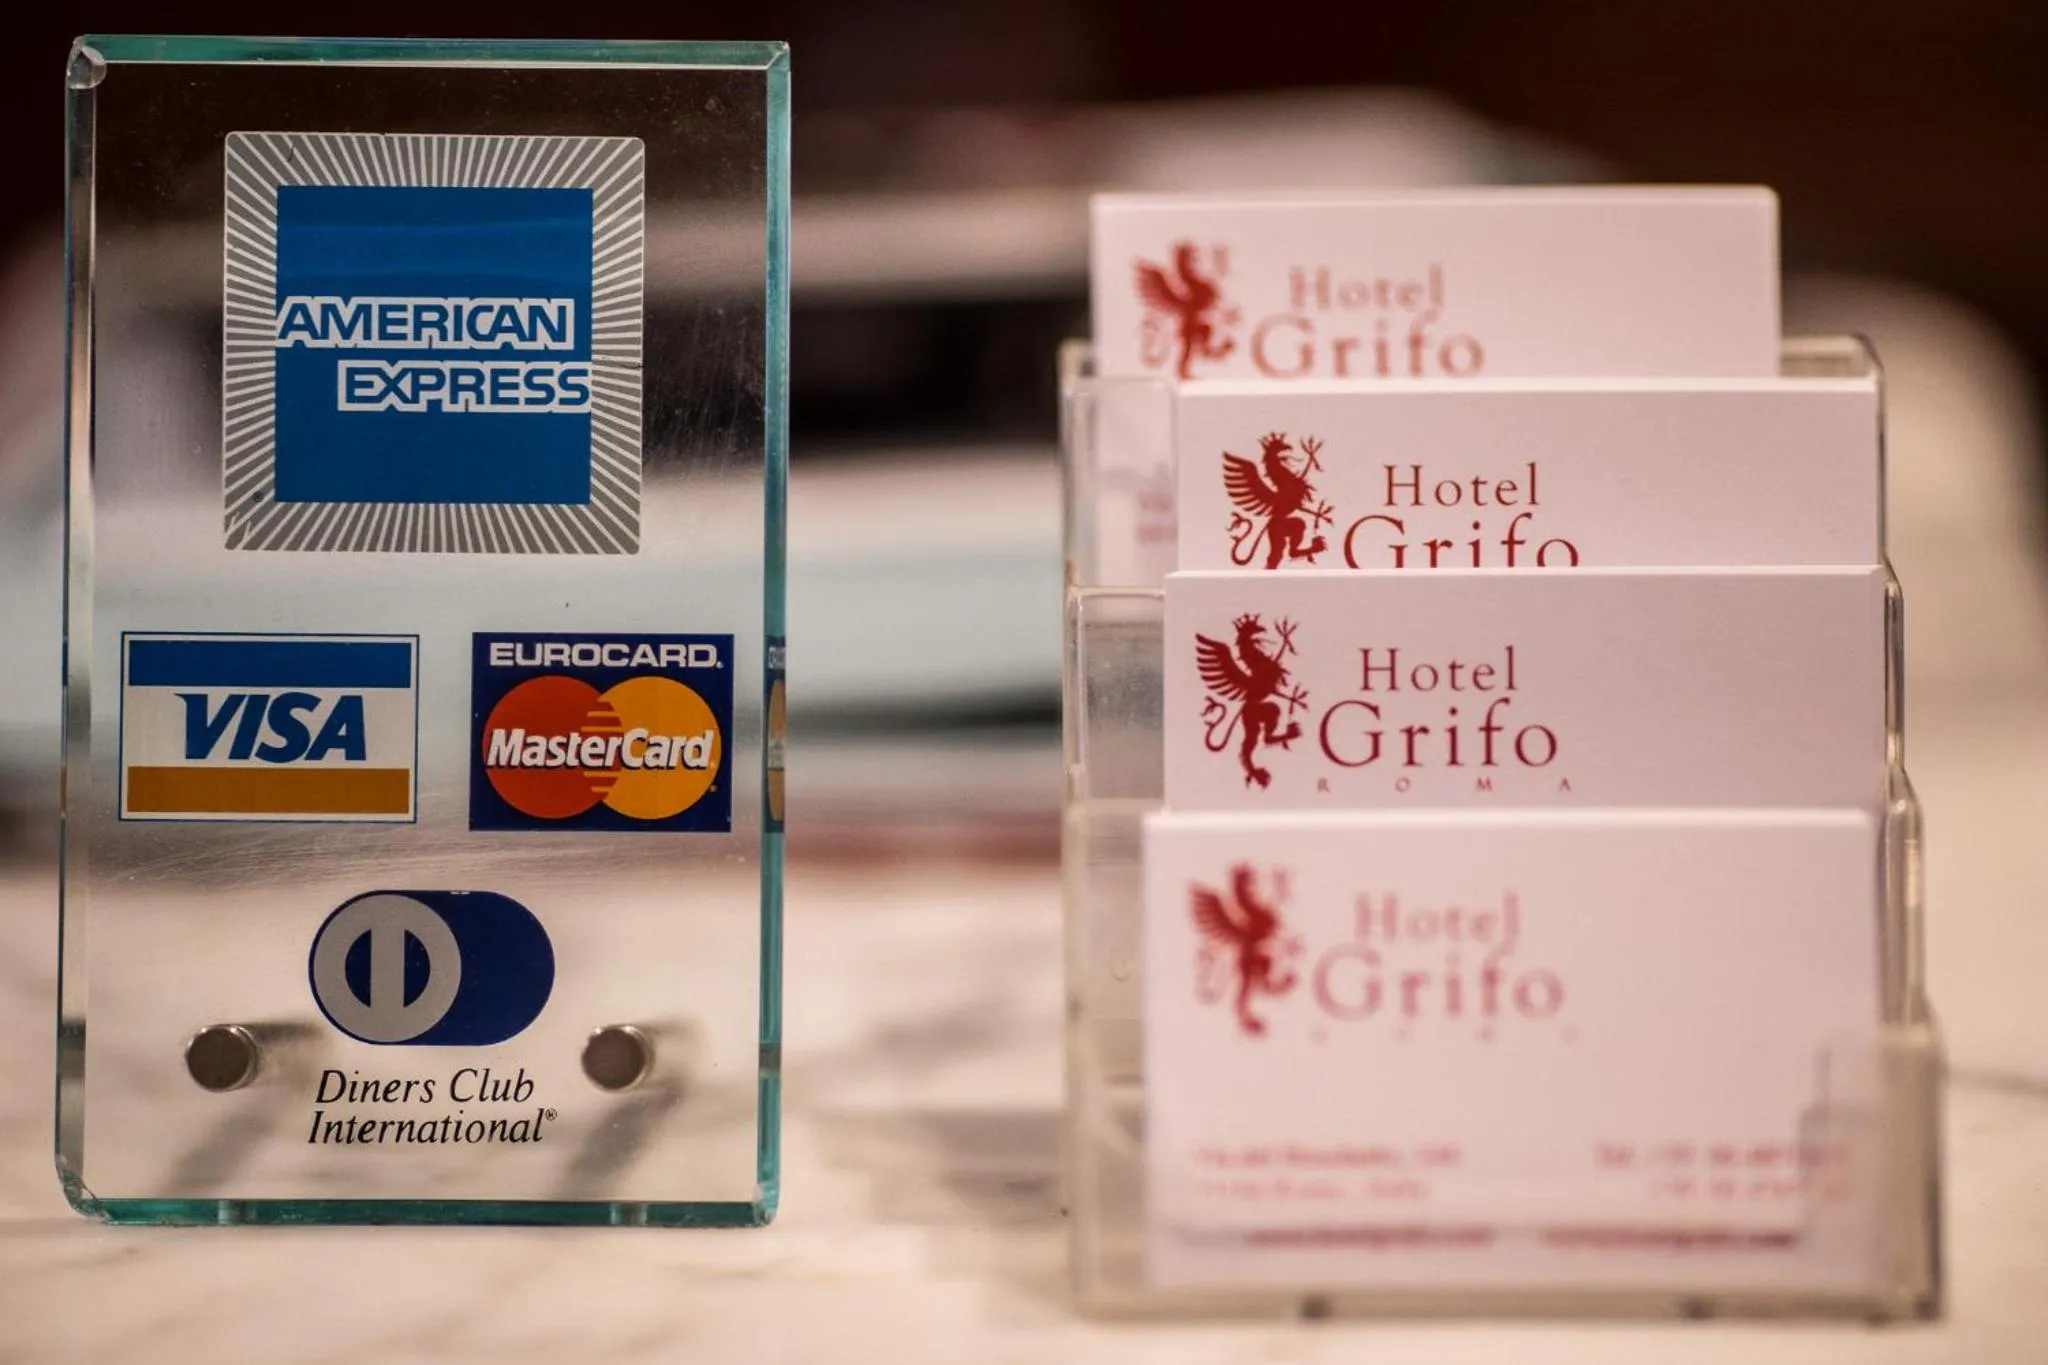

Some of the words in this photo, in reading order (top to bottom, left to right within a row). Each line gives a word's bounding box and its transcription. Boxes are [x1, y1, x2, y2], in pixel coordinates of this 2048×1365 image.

[1289, 263, 1444, 311] Hotel
[275, 296, 574, 349] AMERICAN
[1251, 309, 1485, 380] Grifo
[338, 360, 592, 413] EXPRESS
[1384, 461, 1540, 507] Hotel
[1344, 511, 1579, 568] Grifo
[490, 642, 718, 668] EUROCARD
[1359, 645, 1518, 692] Hotel
[174, 691, 367, 763] VISA
[486, 727, 715, 770] MasterCard
[1319, 697, 1558, 767] Grifo
[315, 1069, 436, 1103] Diners
[449, 1068, 534, 1103] Club
